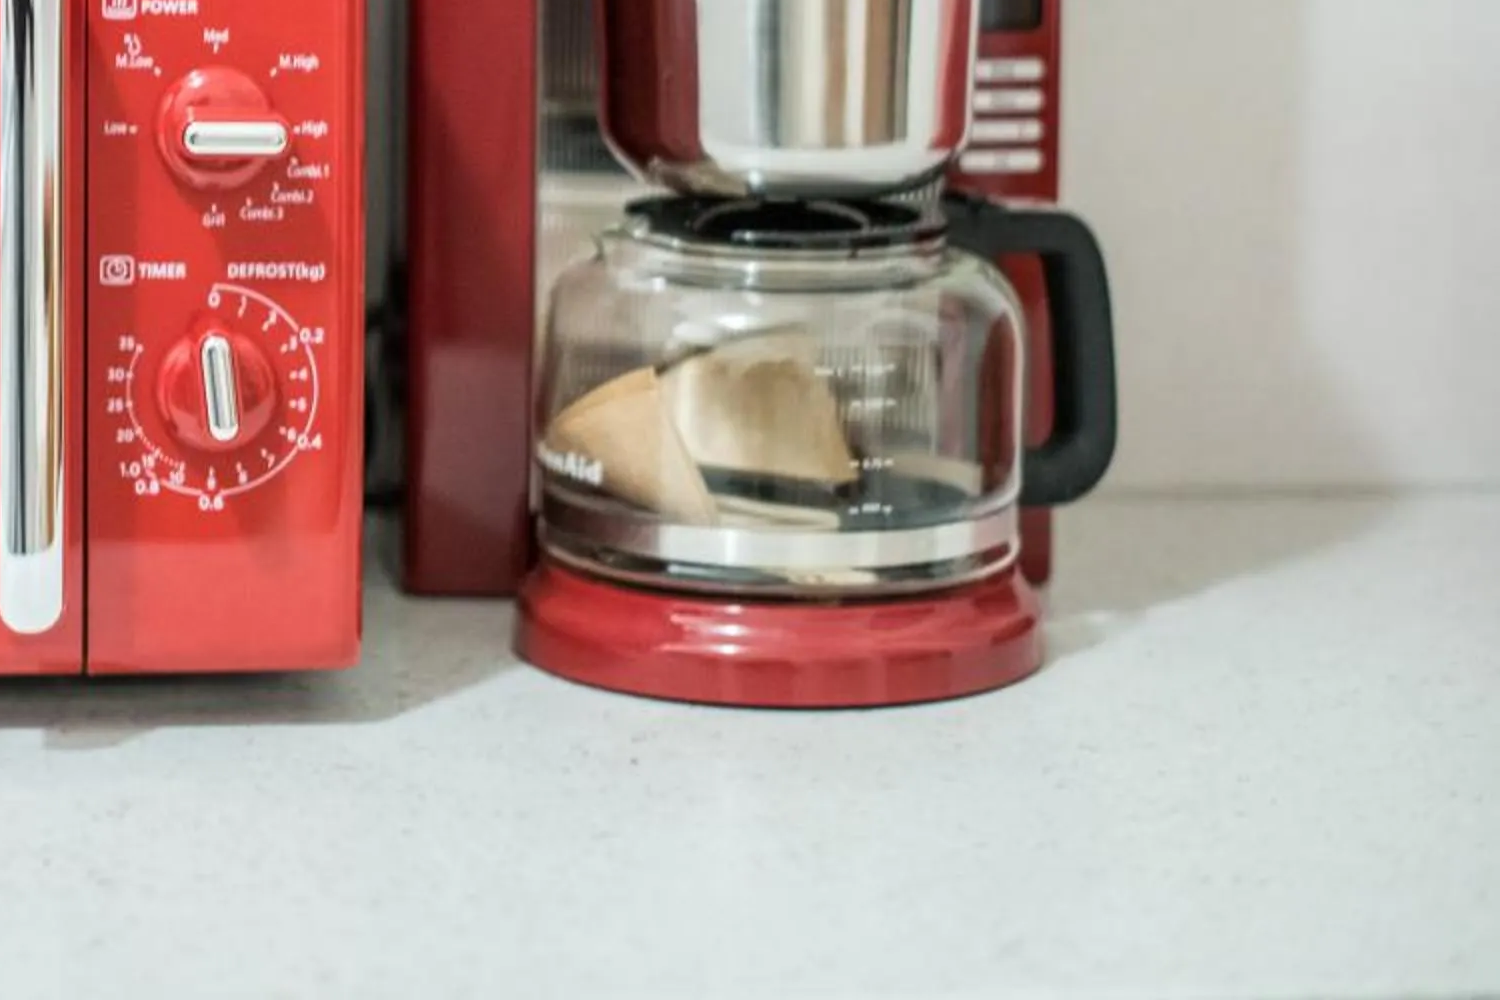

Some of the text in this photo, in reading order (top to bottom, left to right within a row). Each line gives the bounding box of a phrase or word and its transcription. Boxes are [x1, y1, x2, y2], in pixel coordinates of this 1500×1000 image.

[202, 27, 230, 45] Med
[279, 53, 320, 73] M.High
[104, 120, 127, 136] Low
[300, 121, 329, 139] High
[137, 262, 187, 281] TIMER
[207, 291, 221, 309] 0
[299, 327, 325, 344] 0.2
[296, 432, 323, 449] 0.4
[119, 461, 142, 478] 1.0
